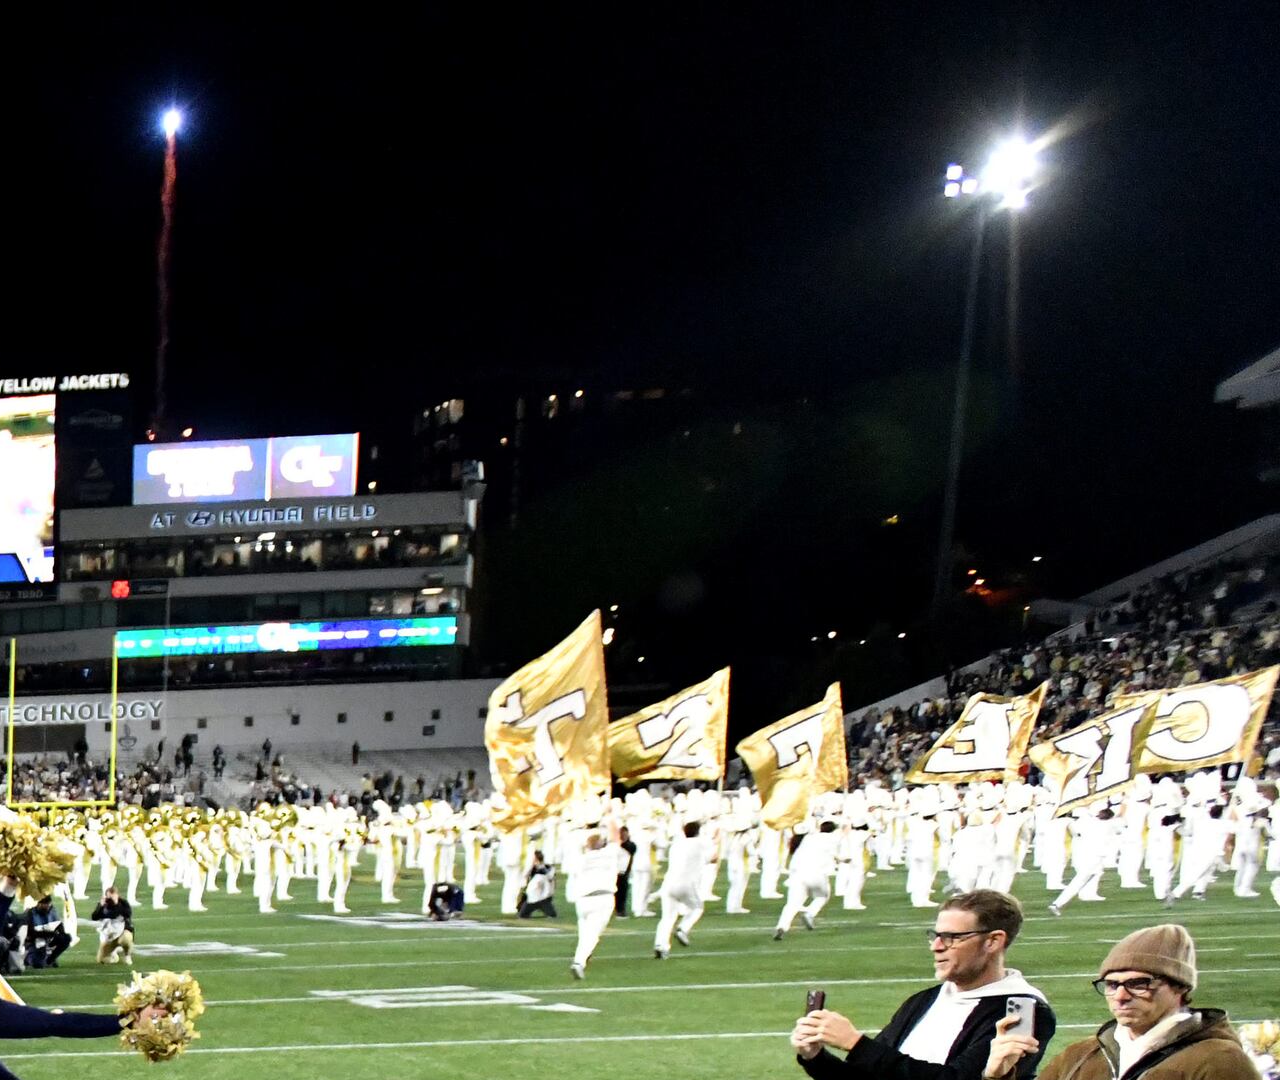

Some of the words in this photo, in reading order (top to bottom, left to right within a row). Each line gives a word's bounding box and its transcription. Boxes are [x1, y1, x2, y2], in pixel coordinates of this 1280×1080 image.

[58, 373, 129, 391] JACKETS
[150, 511, 176, 529] AT
[219, 506, 304, 526] HYUNDAI
[313, 503, 377, 523] FIELD
